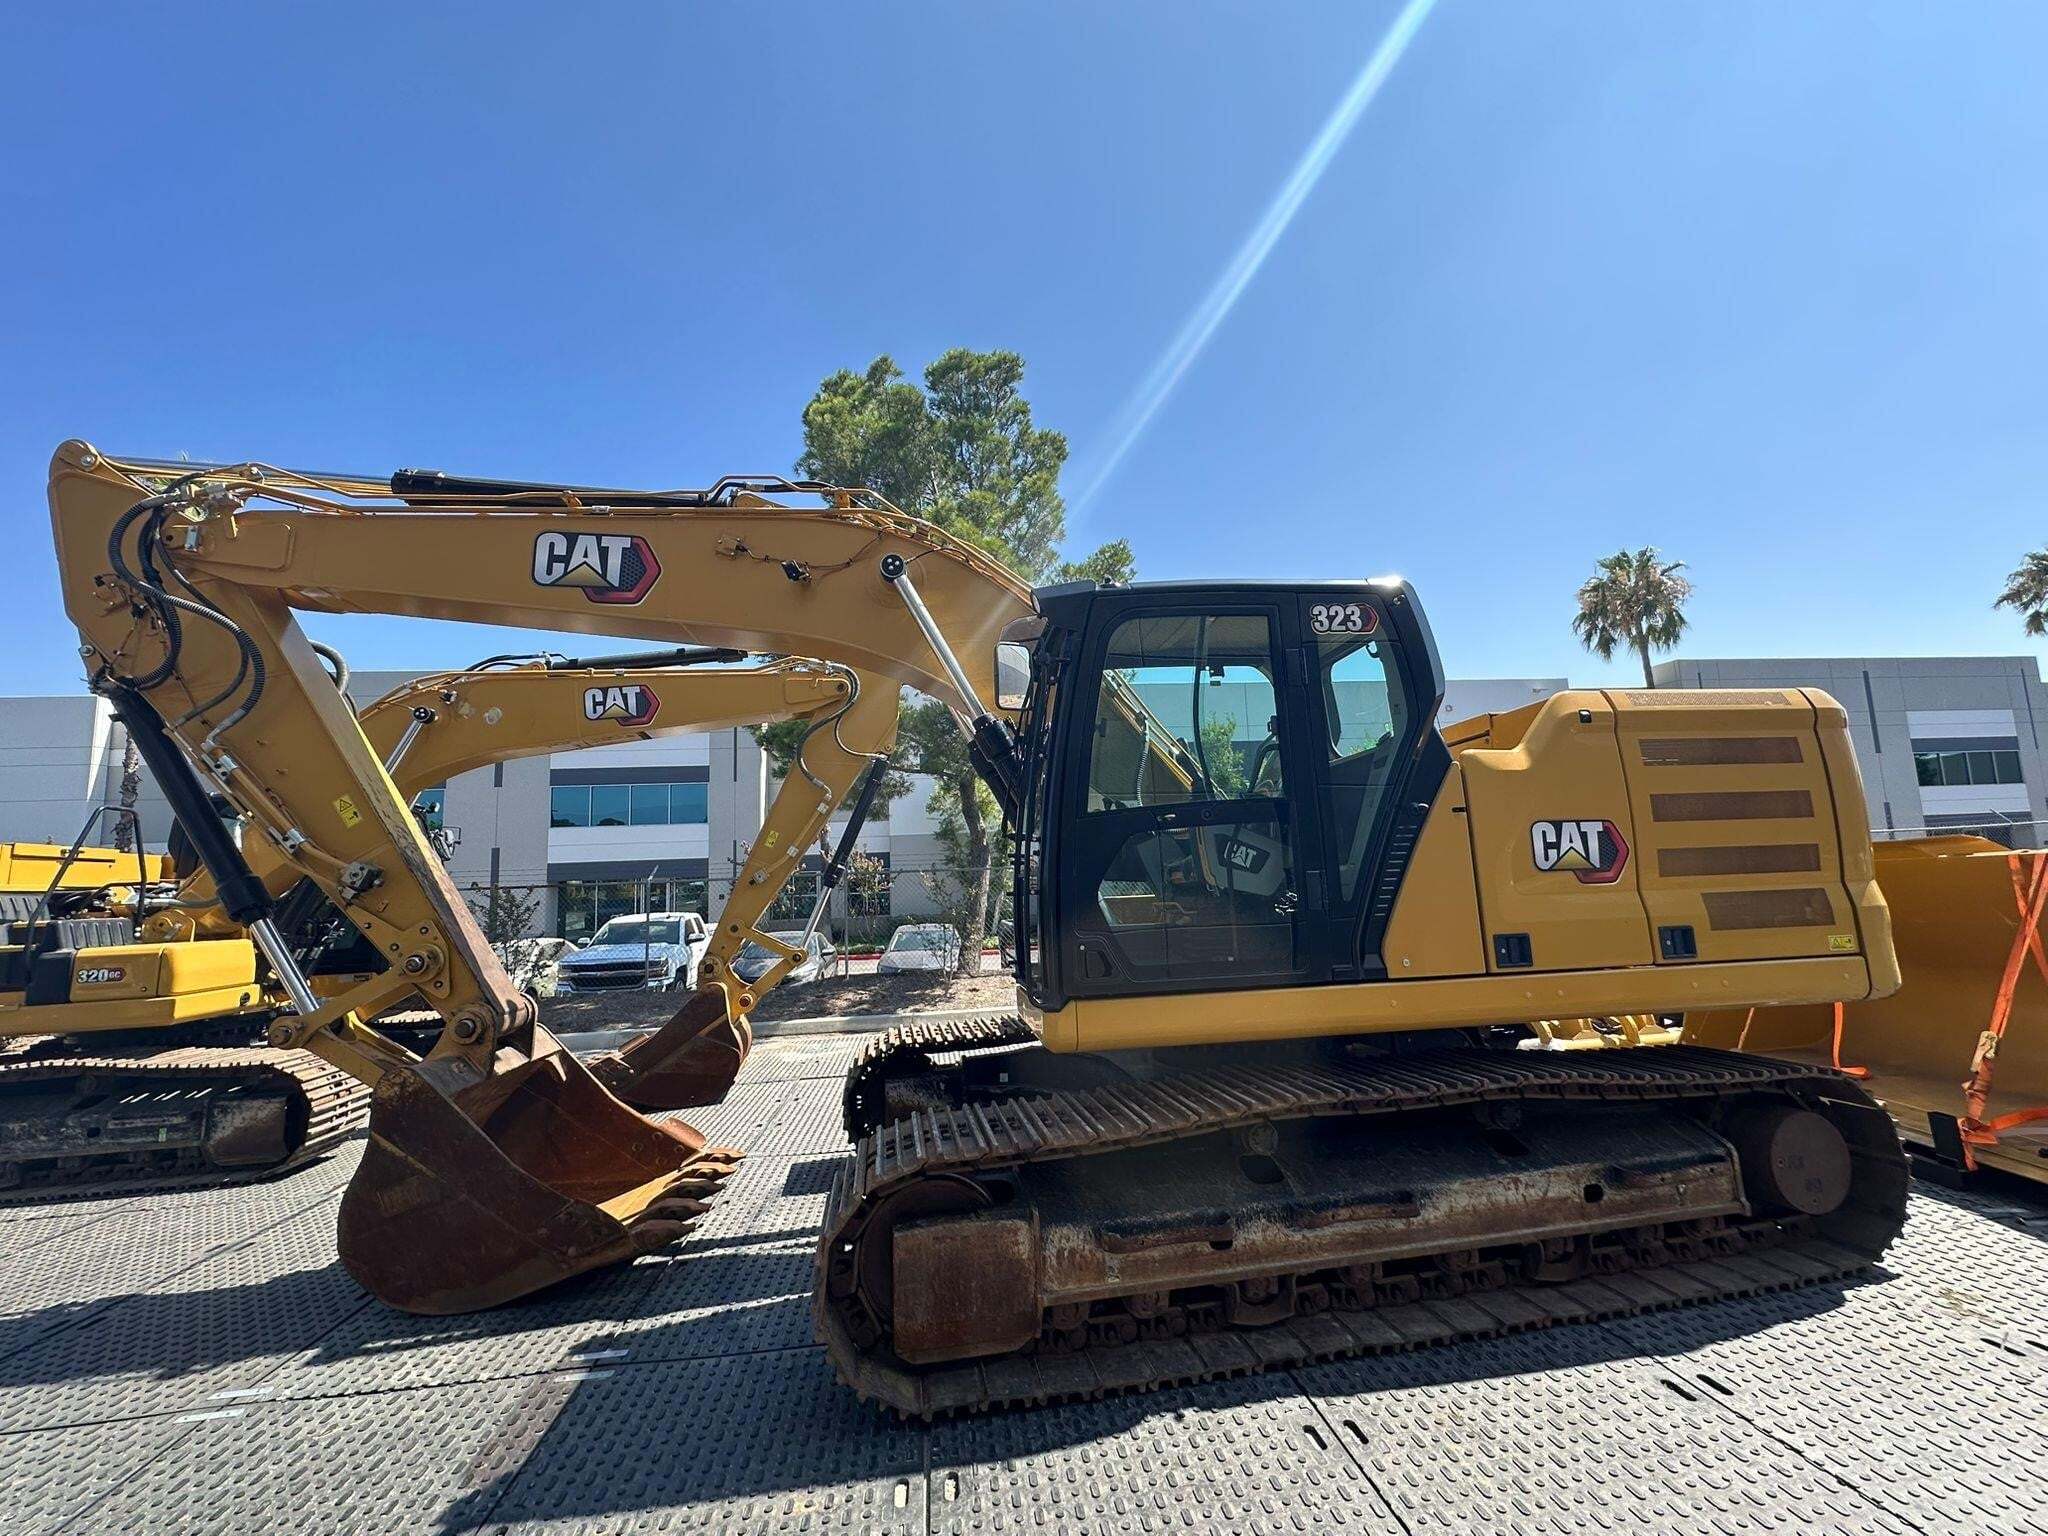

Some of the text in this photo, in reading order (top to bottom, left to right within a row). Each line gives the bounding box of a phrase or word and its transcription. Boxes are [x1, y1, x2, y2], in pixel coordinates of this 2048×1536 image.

[534, 532, 632, 588] CAT
[1312, 604, 1363, 632] 323
[584, 686, 641, 720] CAT
[1531, 821, 1604, 870] CAT
[78, 969, 109, 983] 320
